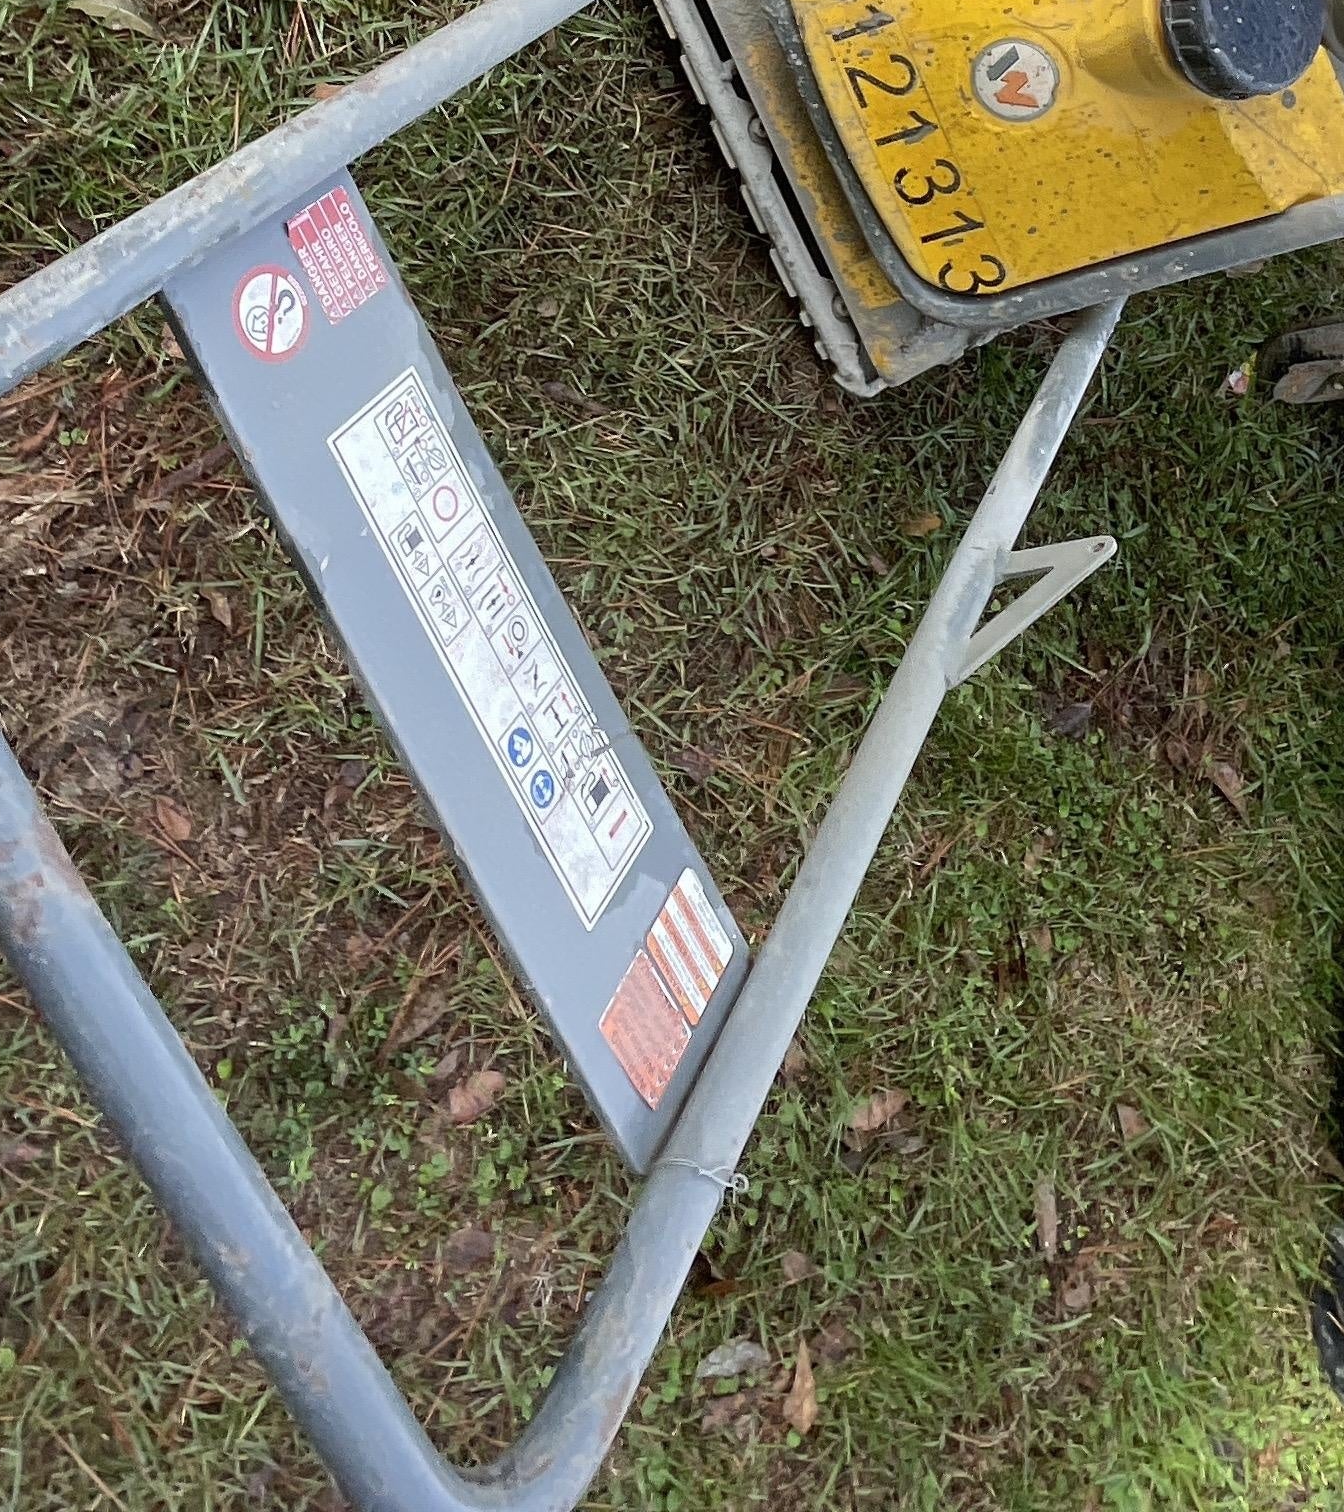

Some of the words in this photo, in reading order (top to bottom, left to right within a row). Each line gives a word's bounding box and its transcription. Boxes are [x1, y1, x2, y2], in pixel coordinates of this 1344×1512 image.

[828, 3, 1006, 295] 121313
[320, 227, 357, 290] PELIGRO
[333, 220, 368, 281] DANGER
[339, 201, 379, 273] PERICOLO
[297, 246, 333, 308] DANGER
[311, 240, 344, 297] GEFAHR
